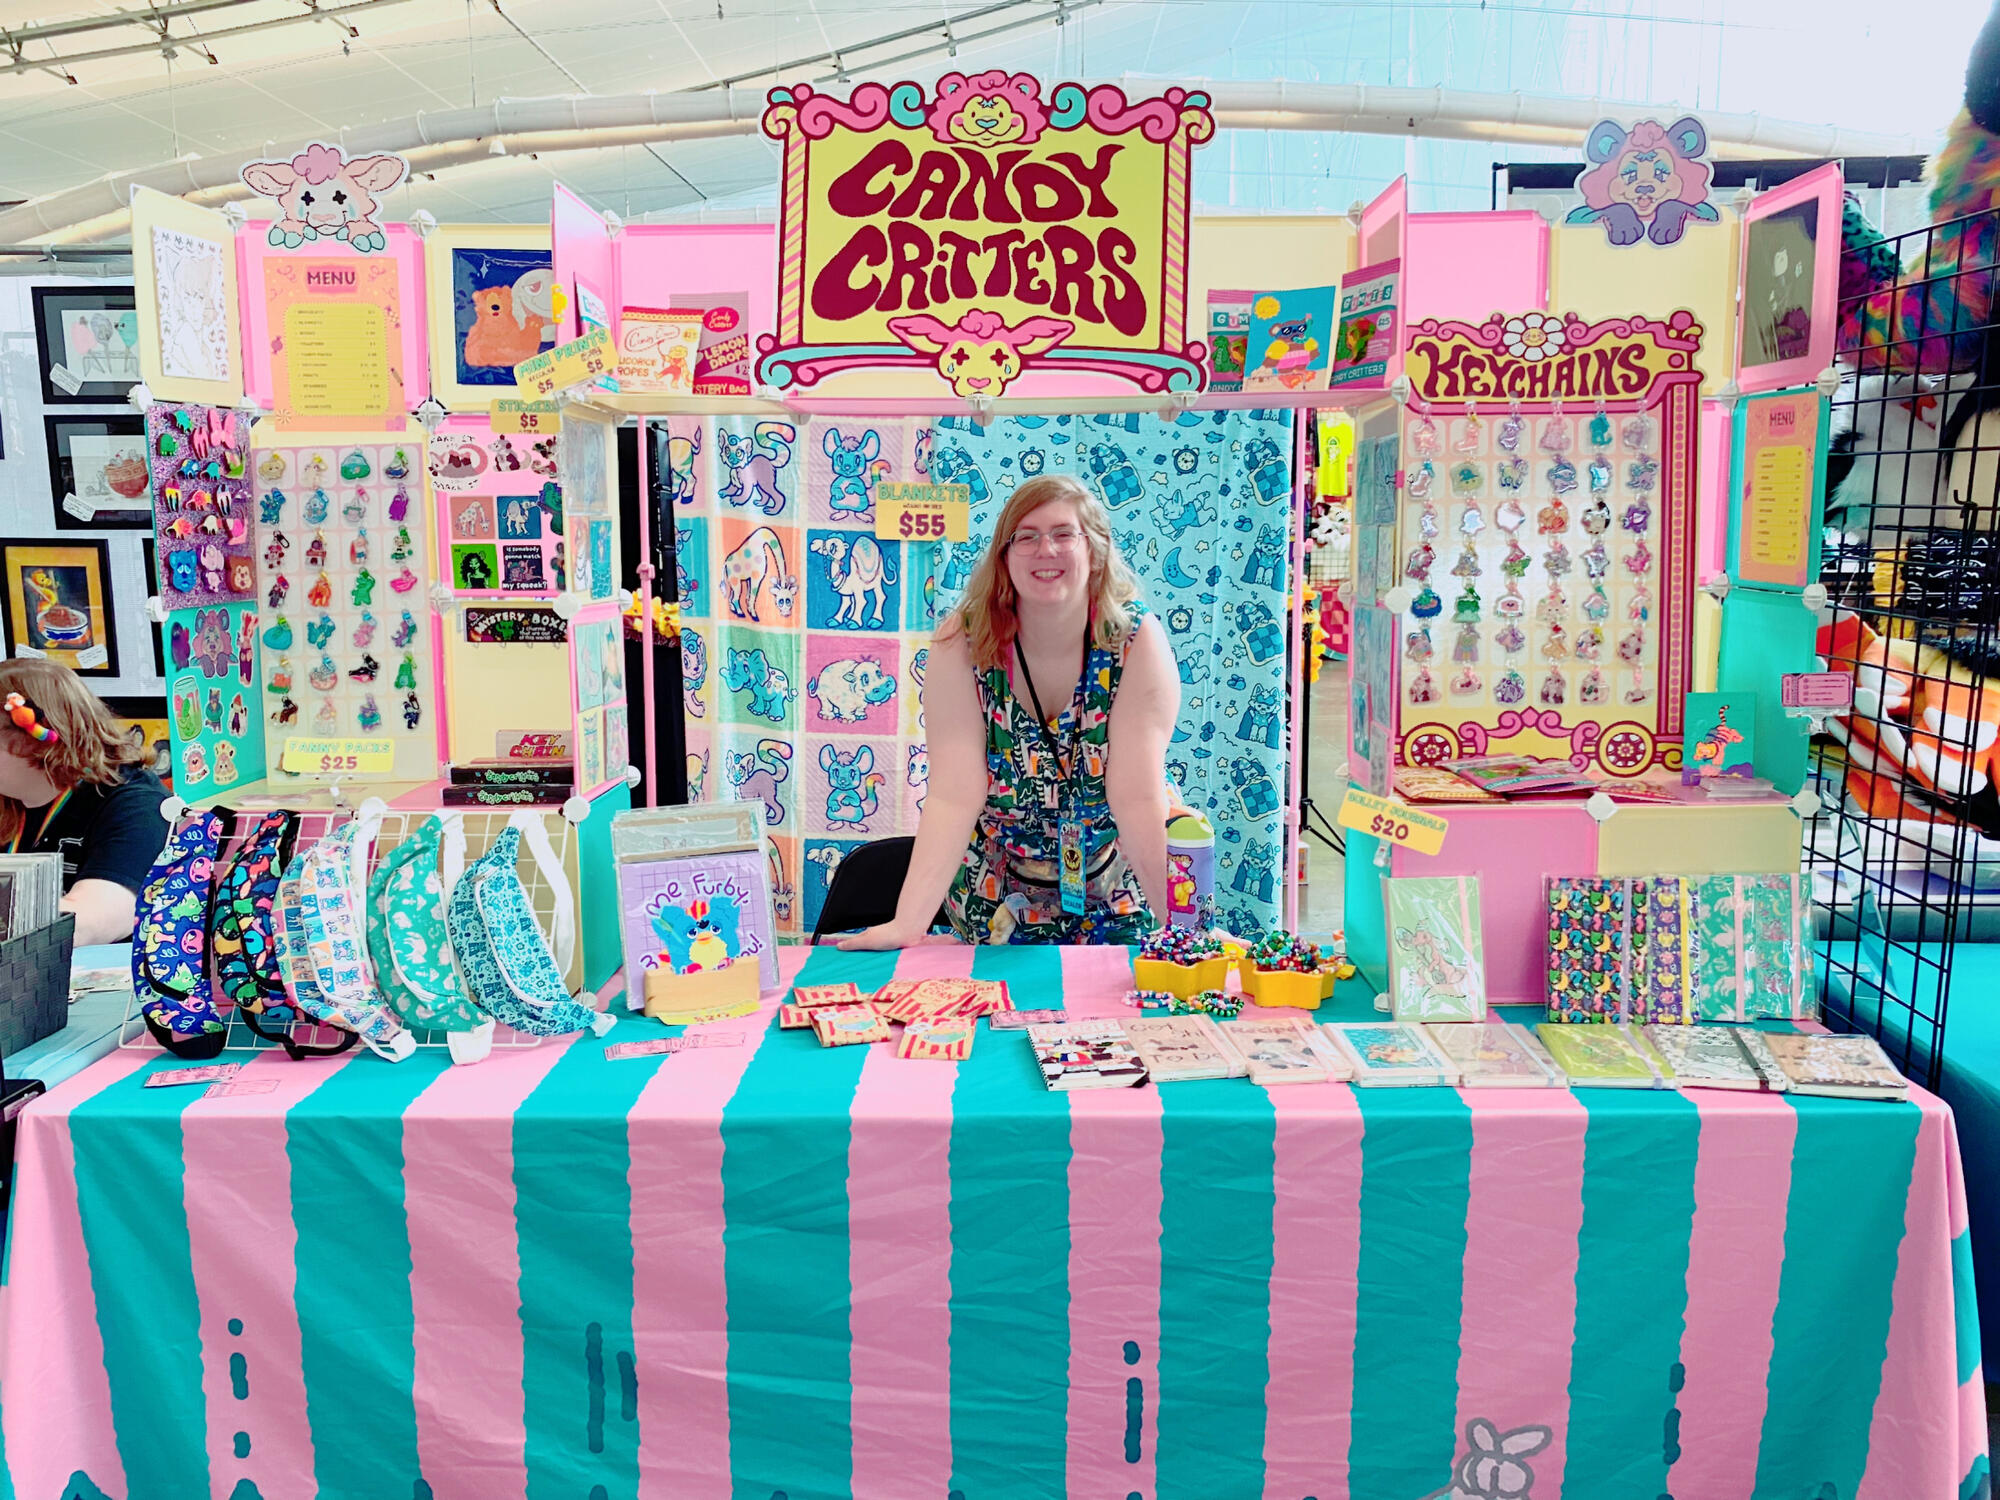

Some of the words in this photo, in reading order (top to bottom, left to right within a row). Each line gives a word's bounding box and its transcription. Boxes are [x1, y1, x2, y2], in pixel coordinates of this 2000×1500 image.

[828, 139, 1125, 223] CANDY
[307, 271, 356, 285] MENU
[520, 353, 551, 378] MINI
[554, 329, 608, 362] PRINTS
[704, 336, 747, 360] LEMON
[587, 359, 603, 374] $8
[709, 346, 750, 370] DROPS
[1348, 365, 1385, 379] CRITTERS
[1415, 342, 1650, 398] KEYCHAINS
[520, 412, 538, 429] $5
[1769, 411, 1795, 427] MENU
[878, 484, 968, 502] BLANKETS
[899, 510, 945, 538] $55
[517, 582, 547, 590] squeak?
[474, 611, 525, 634] MYSTERY
[290, 743, 339, 753] FANNY
[345, 743, 390, 753] PACKS
[520, 734, 561, 745] KEY
[509, 745, 566, 758] CHAIN
[320, 754, 357, 771] $25
[1348, 792, 1388, 812] BULLET
[1390, 806, 1447, 832] JOURNALS
[1370, 814, 1409, 840] $20
[739, 933, 763, 957] ou!
